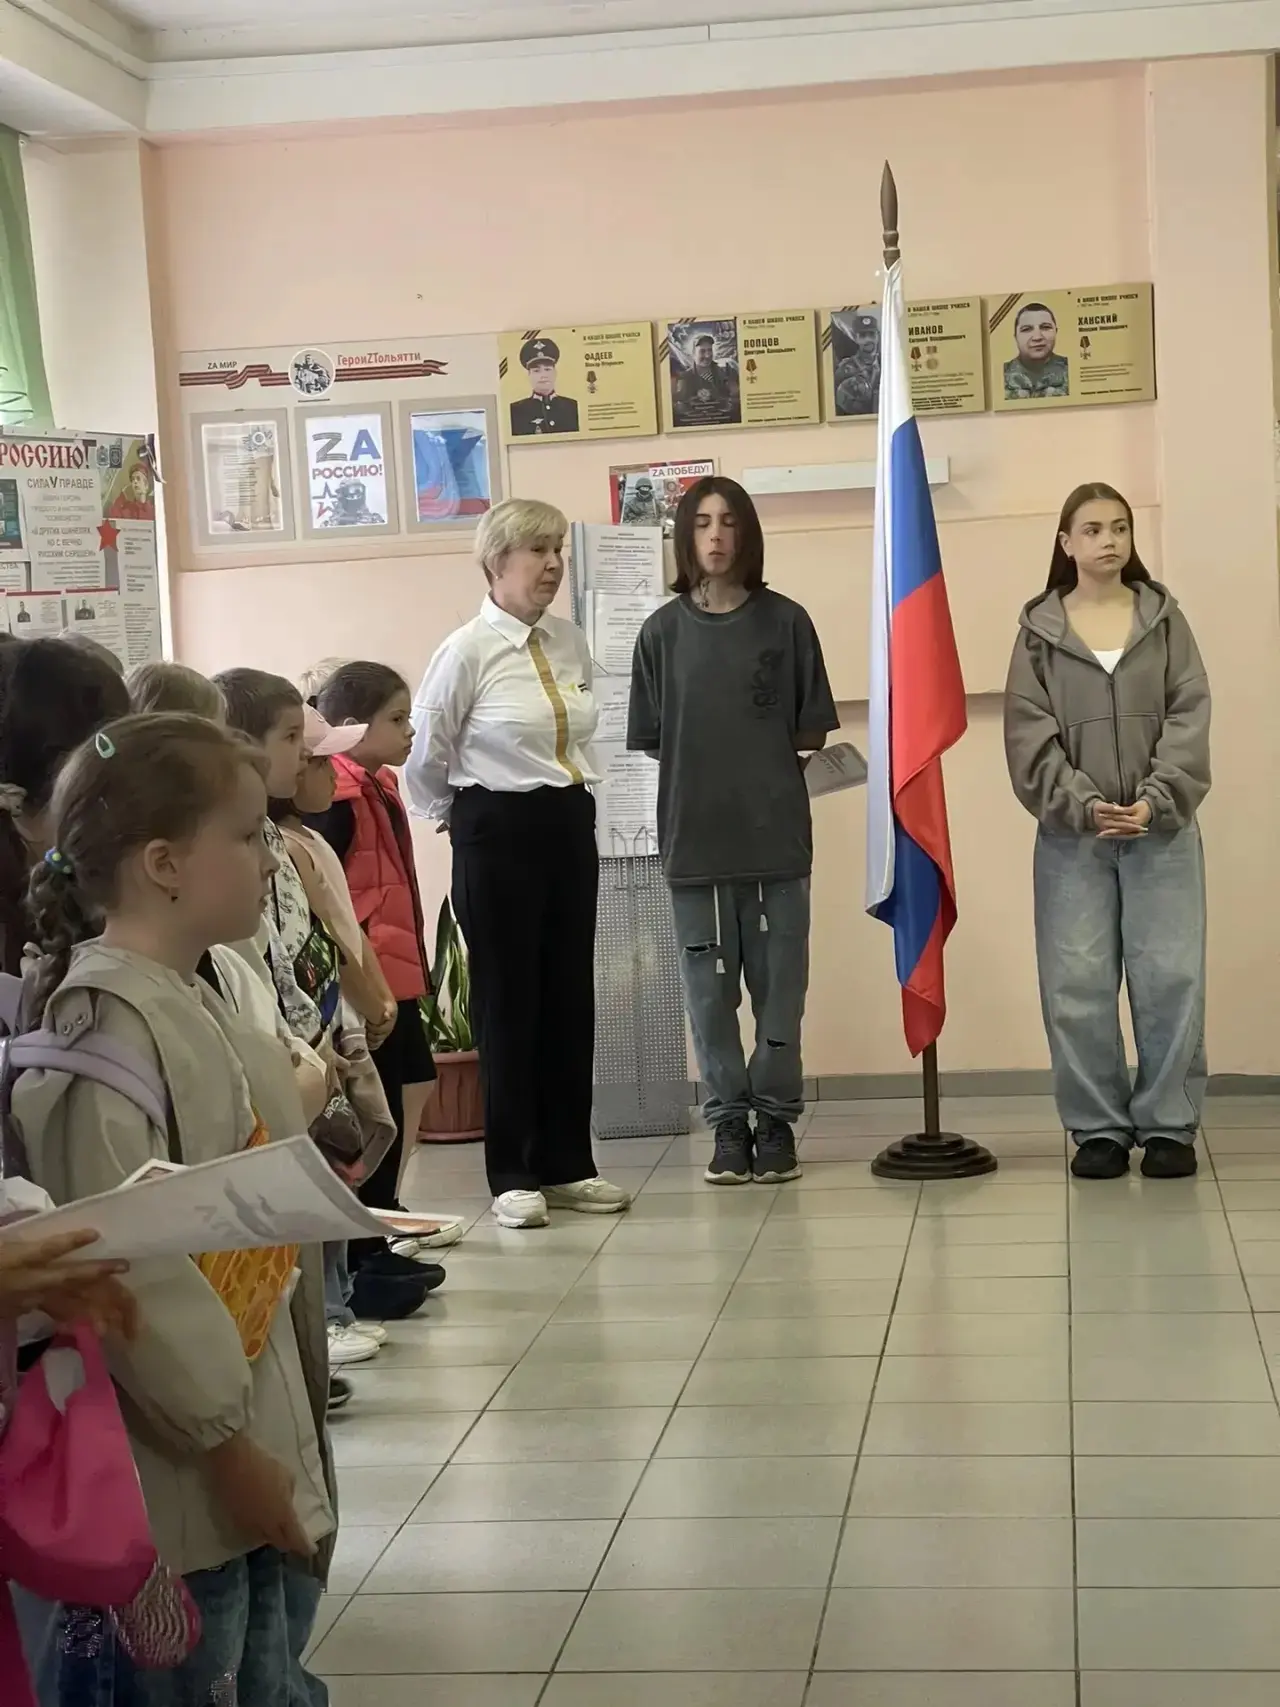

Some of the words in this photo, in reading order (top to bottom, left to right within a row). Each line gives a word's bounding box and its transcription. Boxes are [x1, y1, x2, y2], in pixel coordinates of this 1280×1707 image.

[1077, 312, 1118, 326] ХАНСКИЙ
[907, 324, 944, 336] ИВАНОВ
[743, 337, 779, 349] ПОПЦОВ
[584, 351, 613, 361] ФАДЕЕВ
[219, 361, 238, 369] МИР
[0, 442, 90, 470] РОССИЮ!
[312, 463, 383, 480] РОССИЮ!
[667, 464, 710, 476] ПОБЕДУ!
[60, 478, 94, 489] ПРАВДЕ
